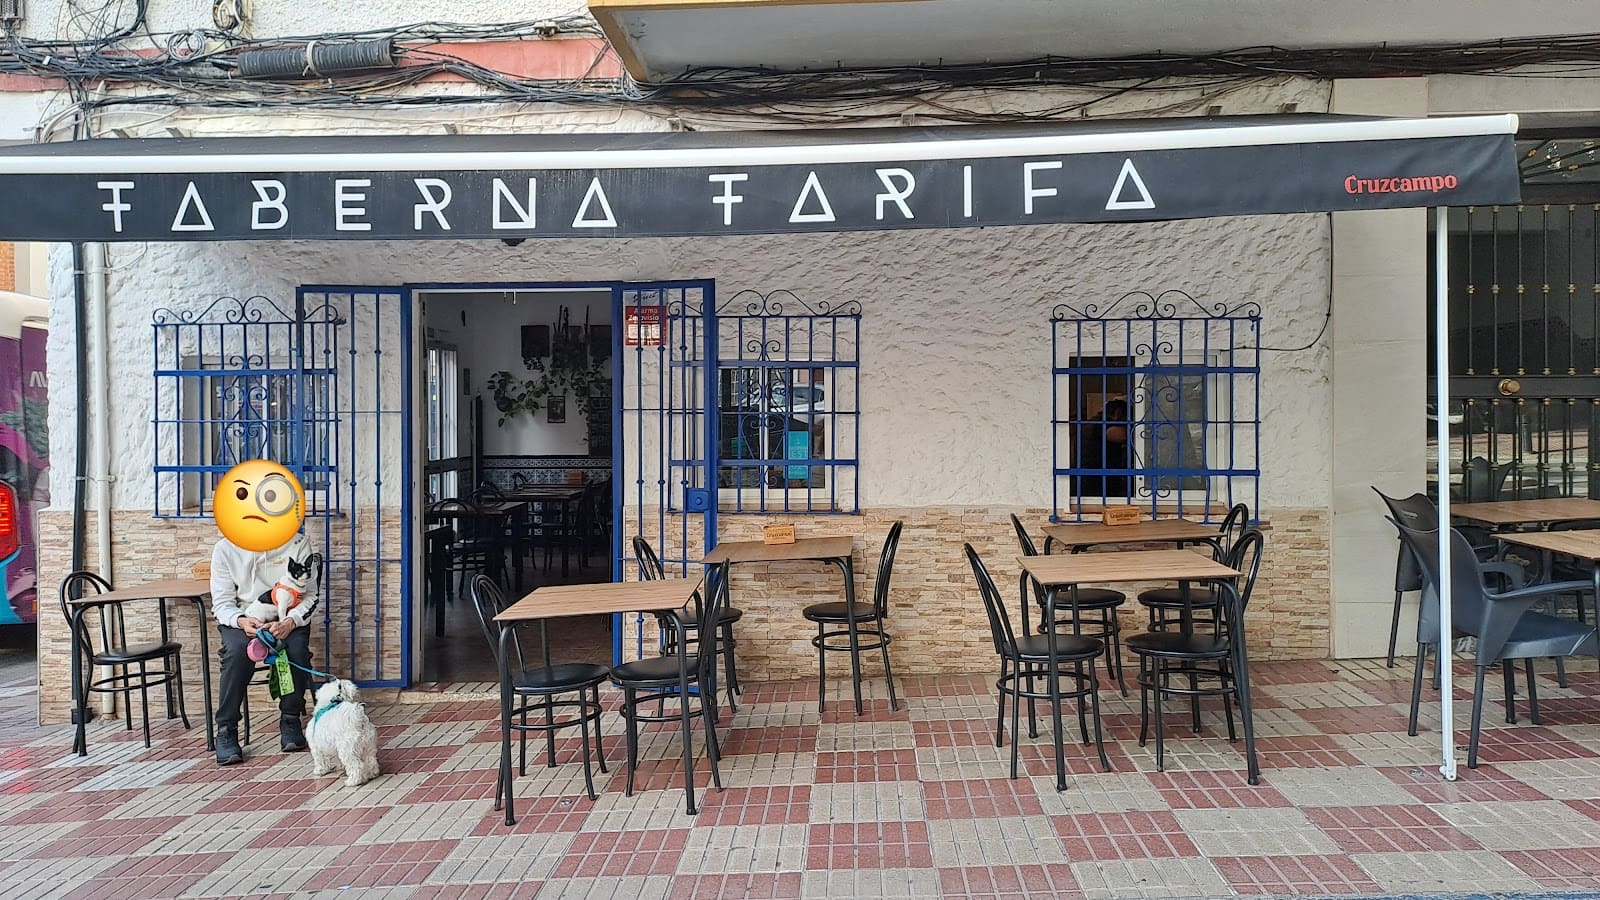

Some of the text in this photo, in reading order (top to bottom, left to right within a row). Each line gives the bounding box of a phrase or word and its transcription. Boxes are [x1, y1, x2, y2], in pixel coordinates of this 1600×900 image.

[97, 158, 1156, 233] TABERNA TARIFA
[1344, 174, 1458, 194] Cruzcampo
